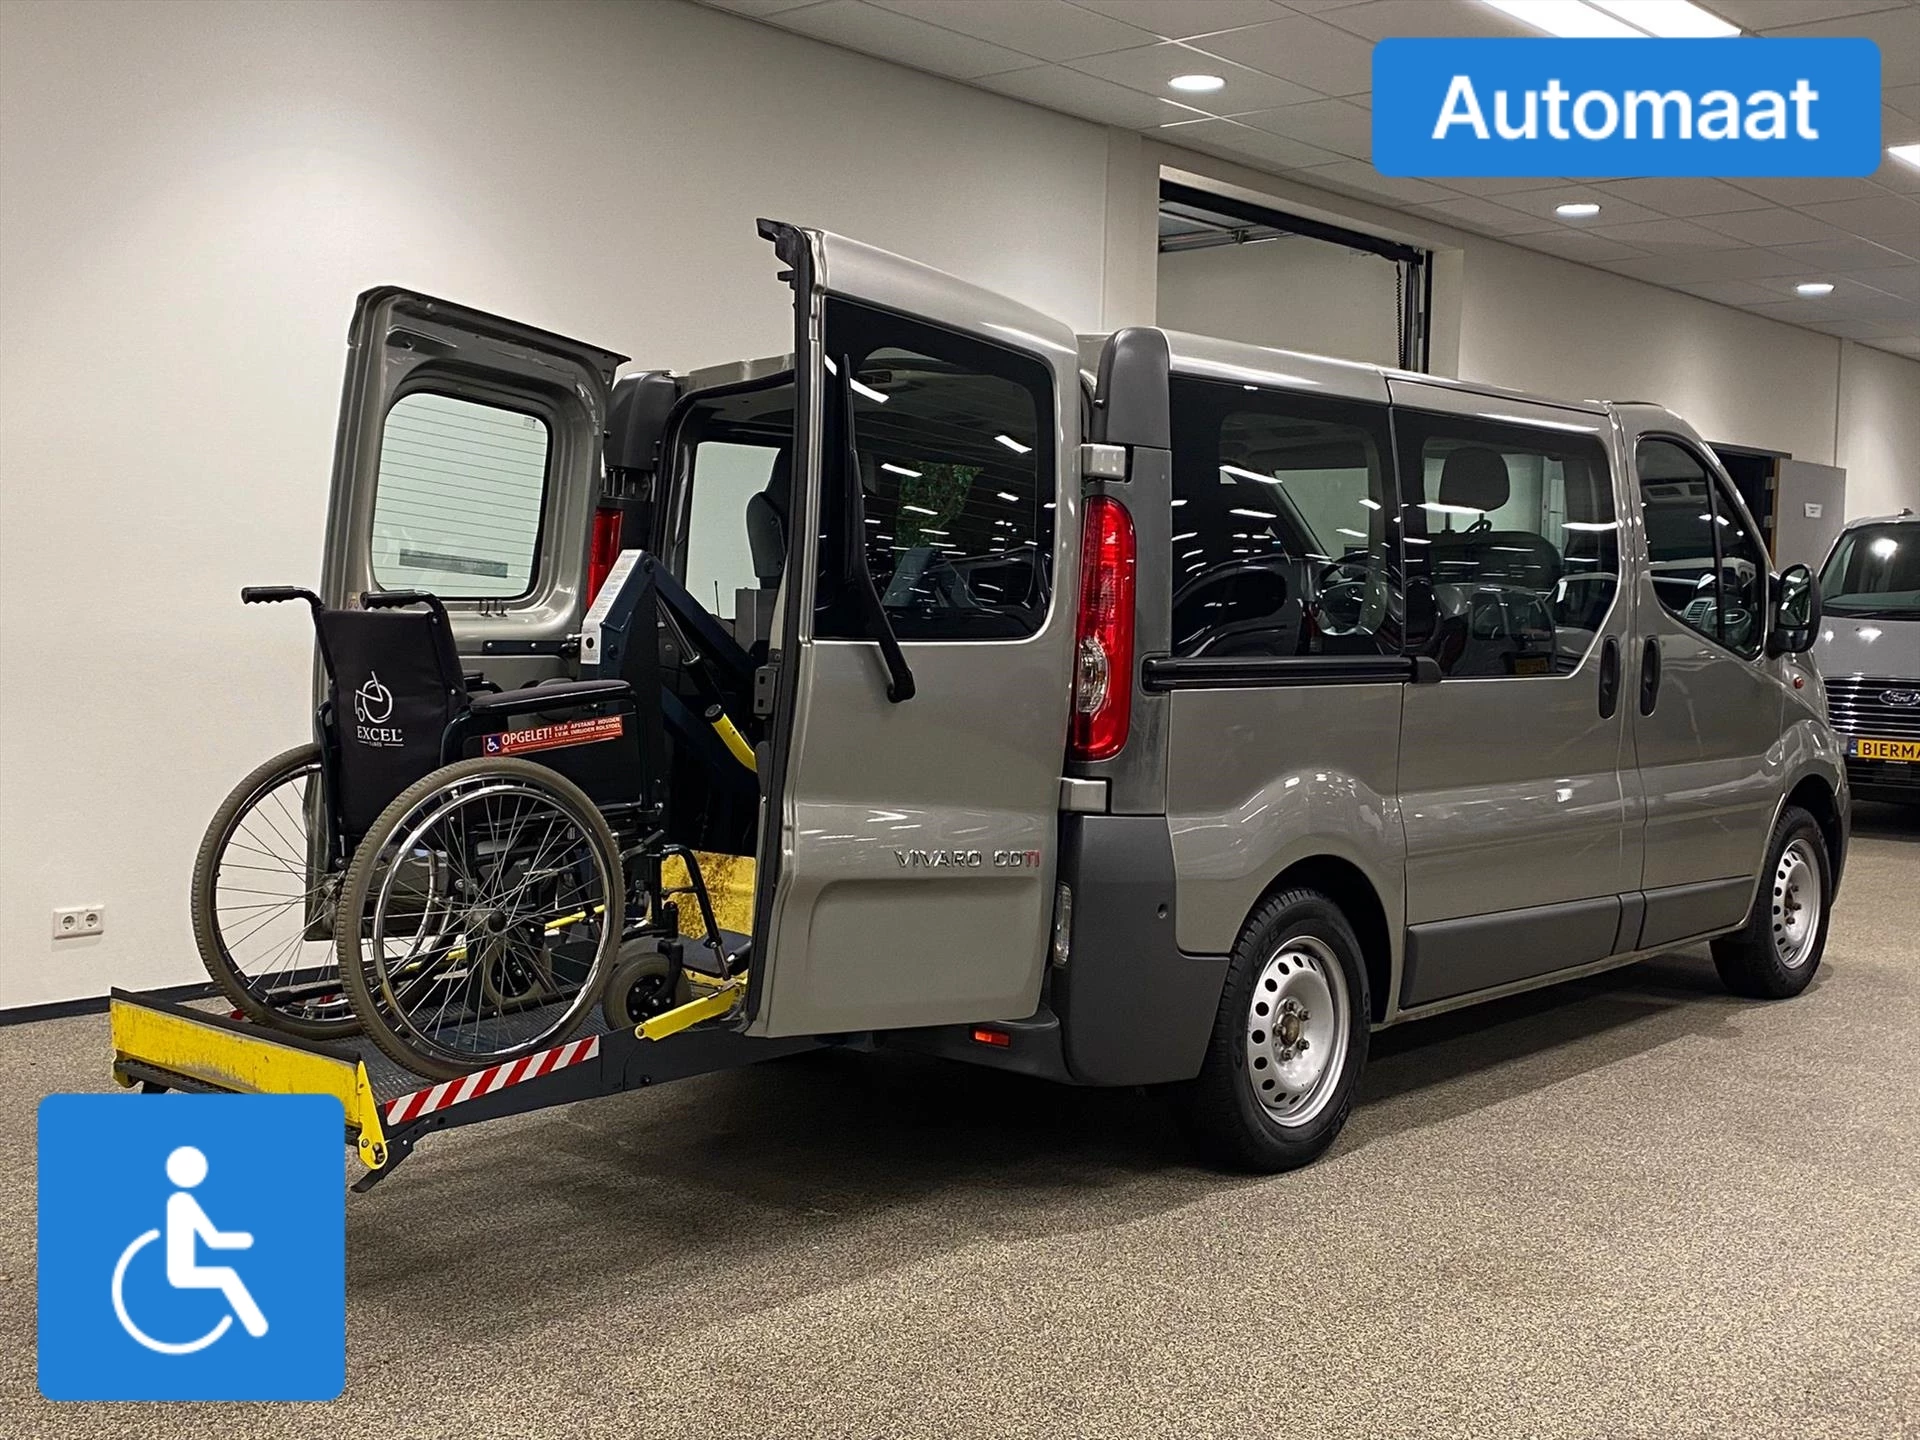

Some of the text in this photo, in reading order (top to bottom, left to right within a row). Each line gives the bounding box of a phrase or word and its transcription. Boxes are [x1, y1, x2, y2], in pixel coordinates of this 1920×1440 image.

[356, 725, 403, 742] EXCEL
[501, 727, 552, 746] OPGELET!
[894, 849, 1040, 868] VIVARO CDTI
